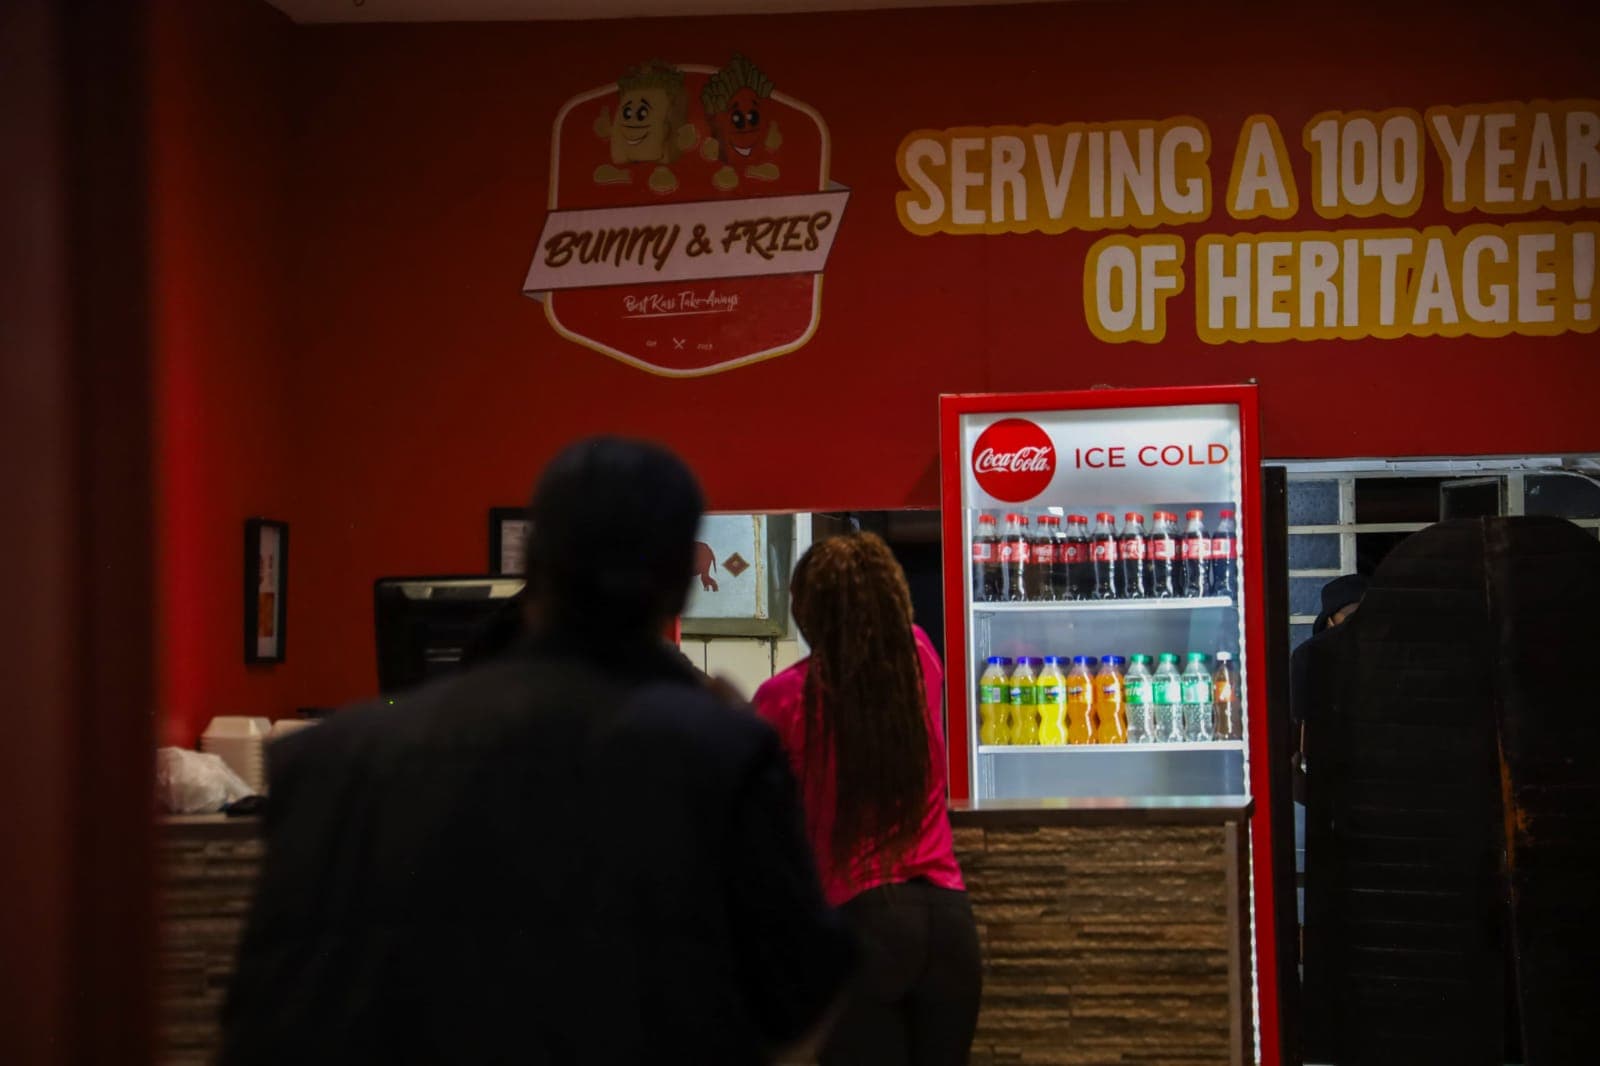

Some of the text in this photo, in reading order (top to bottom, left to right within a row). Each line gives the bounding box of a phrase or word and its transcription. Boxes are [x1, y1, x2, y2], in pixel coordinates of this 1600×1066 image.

[904, 111, 1600, 226] SERVING A 100 YEAR
[543, 211, 832, 271] BUNNY & FRIES
[623, 295, 649, 313] Best
[1096, 232, 1596, 332] OF HERITAGE!
[975, 446, 1051, 474] Coca-Cola
[1075, 444, 1229, 469] ICE COLD
